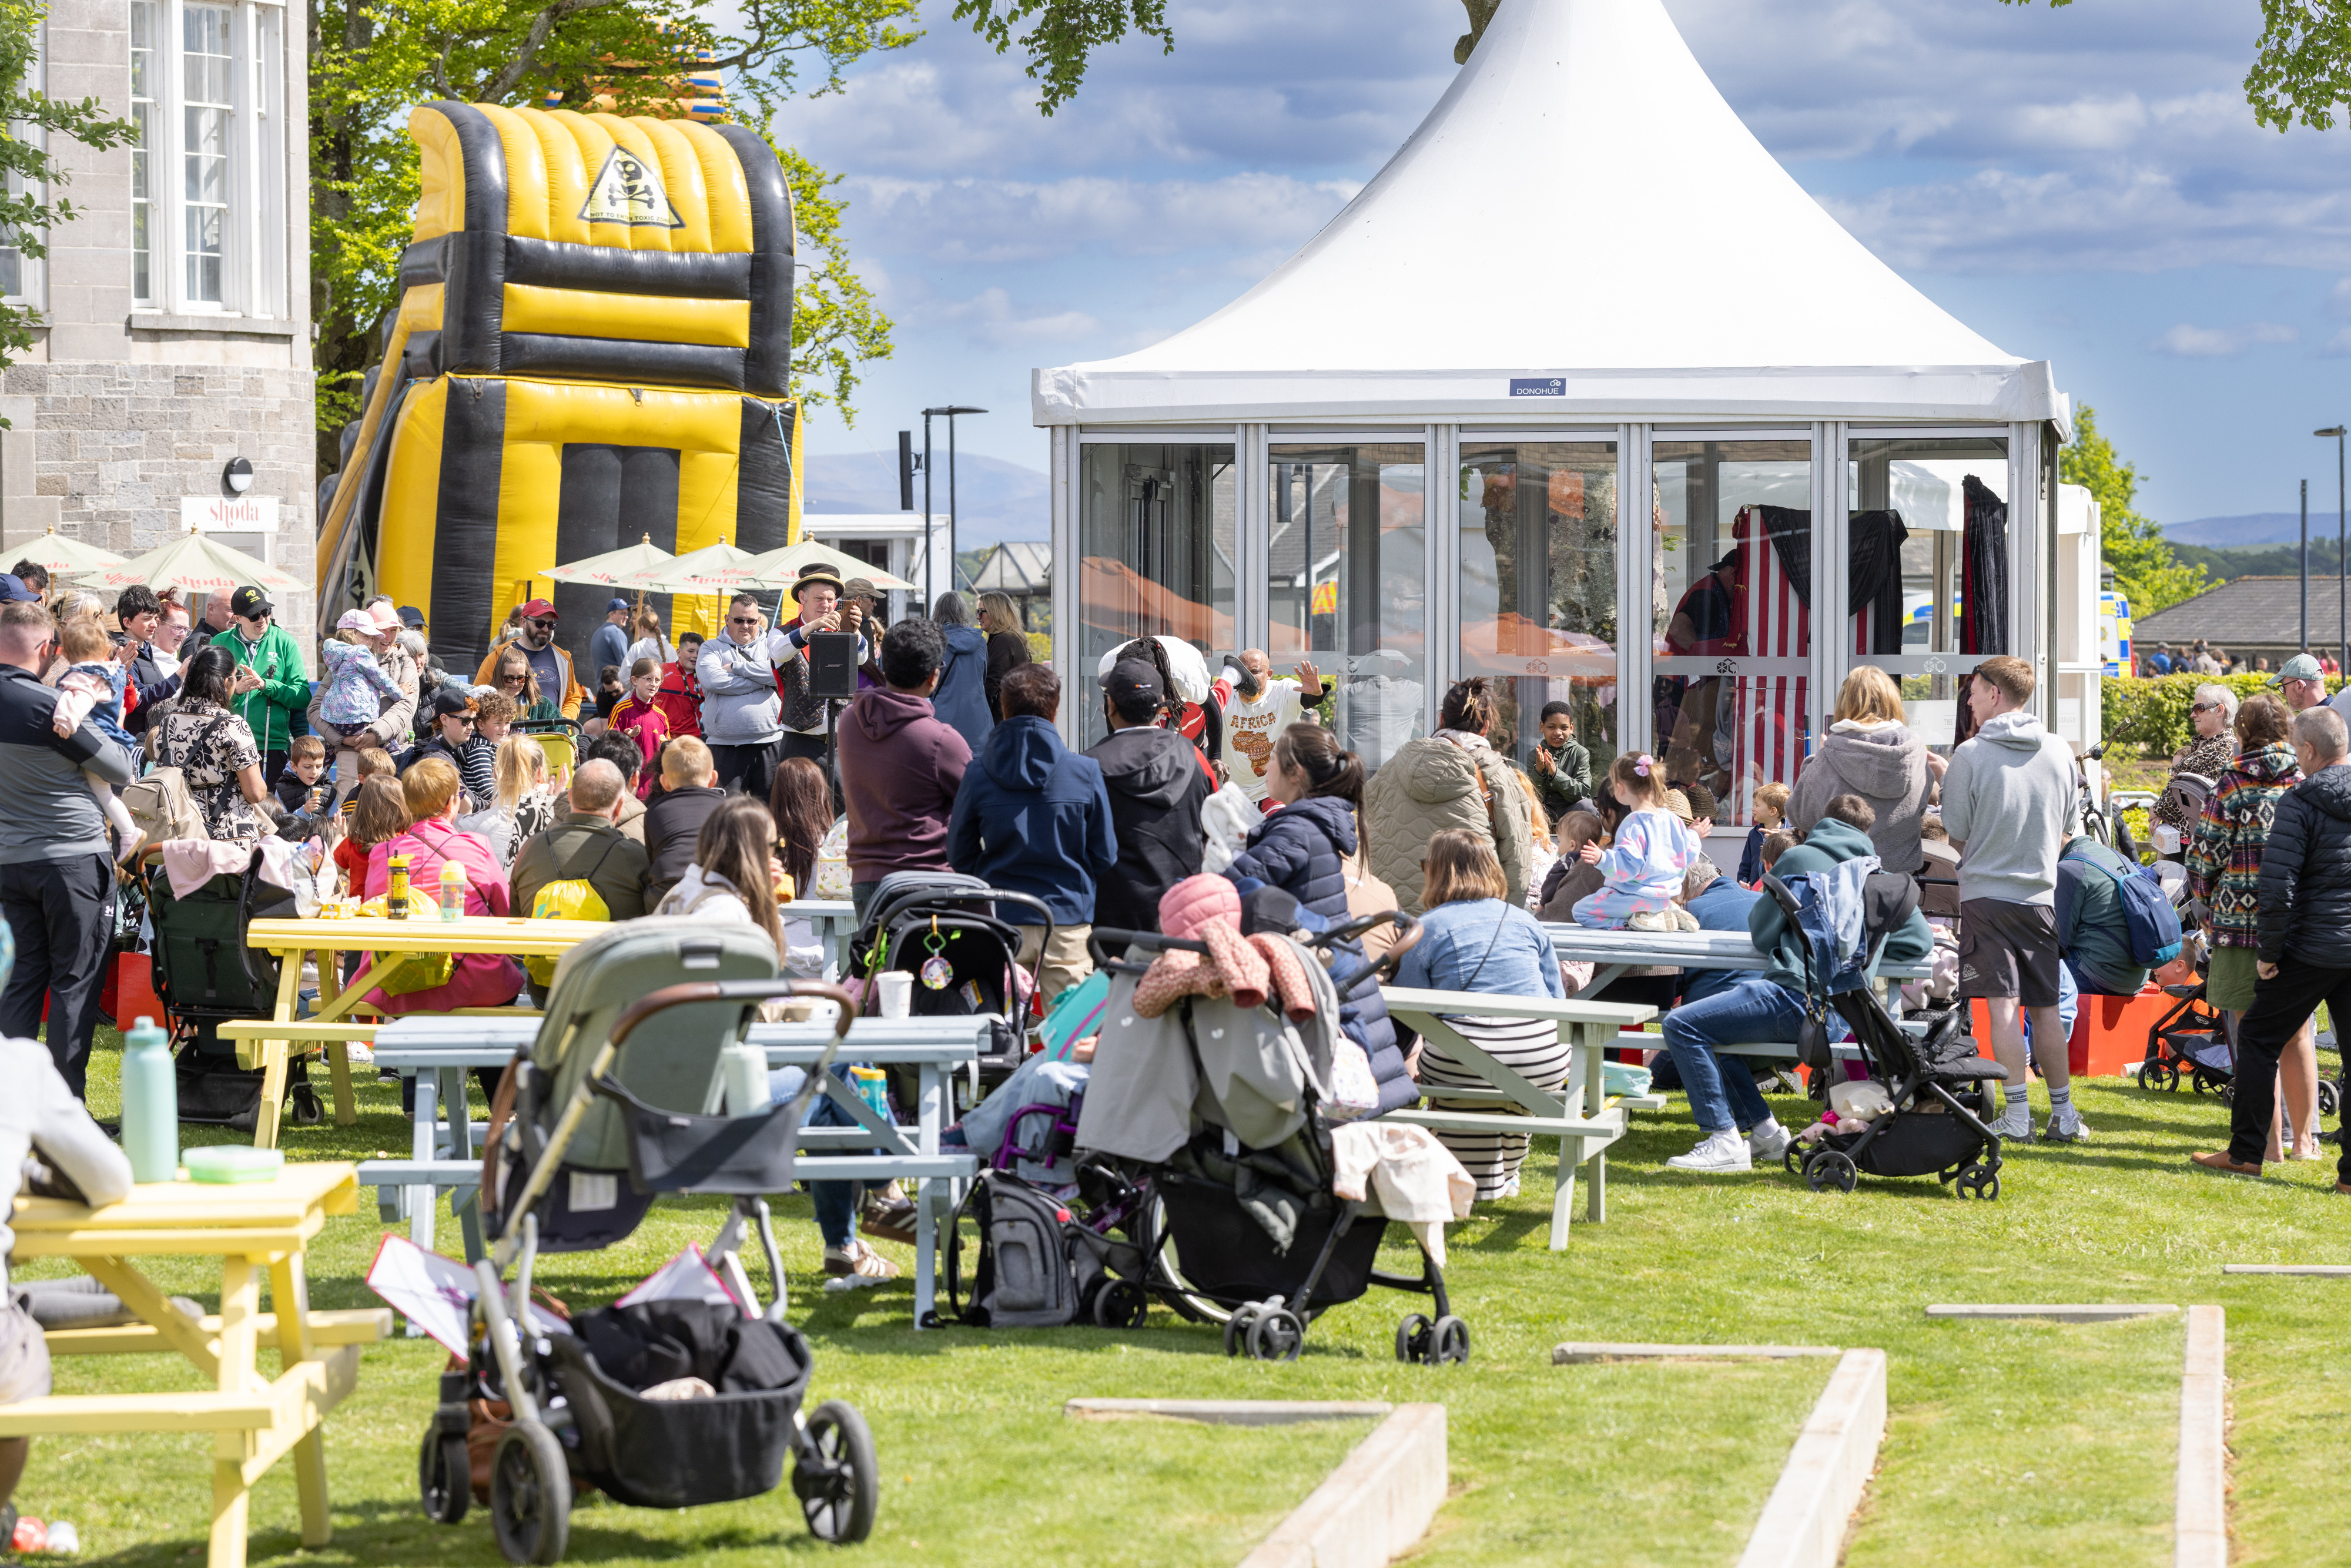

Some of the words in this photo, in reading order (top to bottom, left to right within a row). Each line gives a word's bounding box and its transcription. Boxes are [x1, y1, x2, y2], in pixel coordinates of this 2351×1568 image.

[210, 500, 259, 529] shoda
[101, 572, 146, 585] shoda
[172, 575, 236, 589] shoda
[1230, 712, 1276, 729] AFRICA
